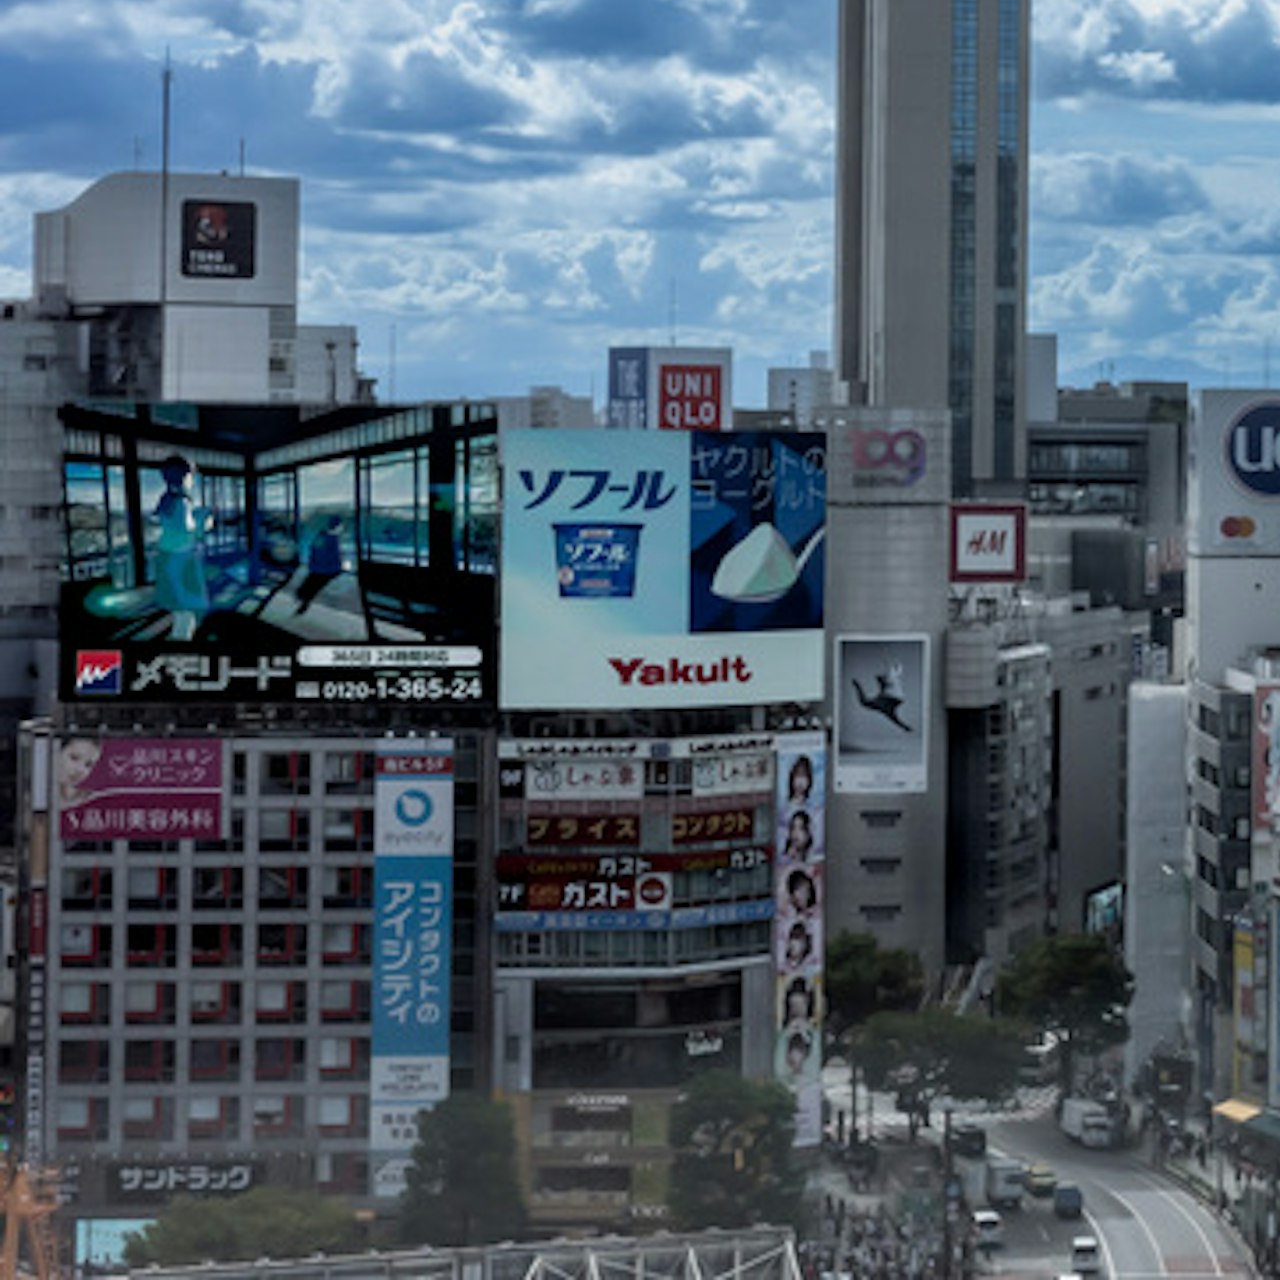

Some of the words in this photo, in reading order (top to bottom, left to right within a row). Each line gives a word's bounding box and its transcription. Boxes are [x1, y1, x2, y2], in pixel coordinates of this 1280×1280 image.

[665, 373, 712, 397] UNI
[665, 401, 716, 428] QLO
[692, 445, 825, 476] ヤクルトの
[519, 470, 678, 511] ソフール
[692, 480, 825, 510] ヨーグルト
[130, 655, 292, 691] メモリード
[608, 657, 753, 686] Yakult
[562, 881, 634, 907] ガスト
[381, 882, 414, 1024] アイシティ
[417, 882, 441, 1024] コンタクトの
[119, 1166, 251, 1190] サンドラッグ
